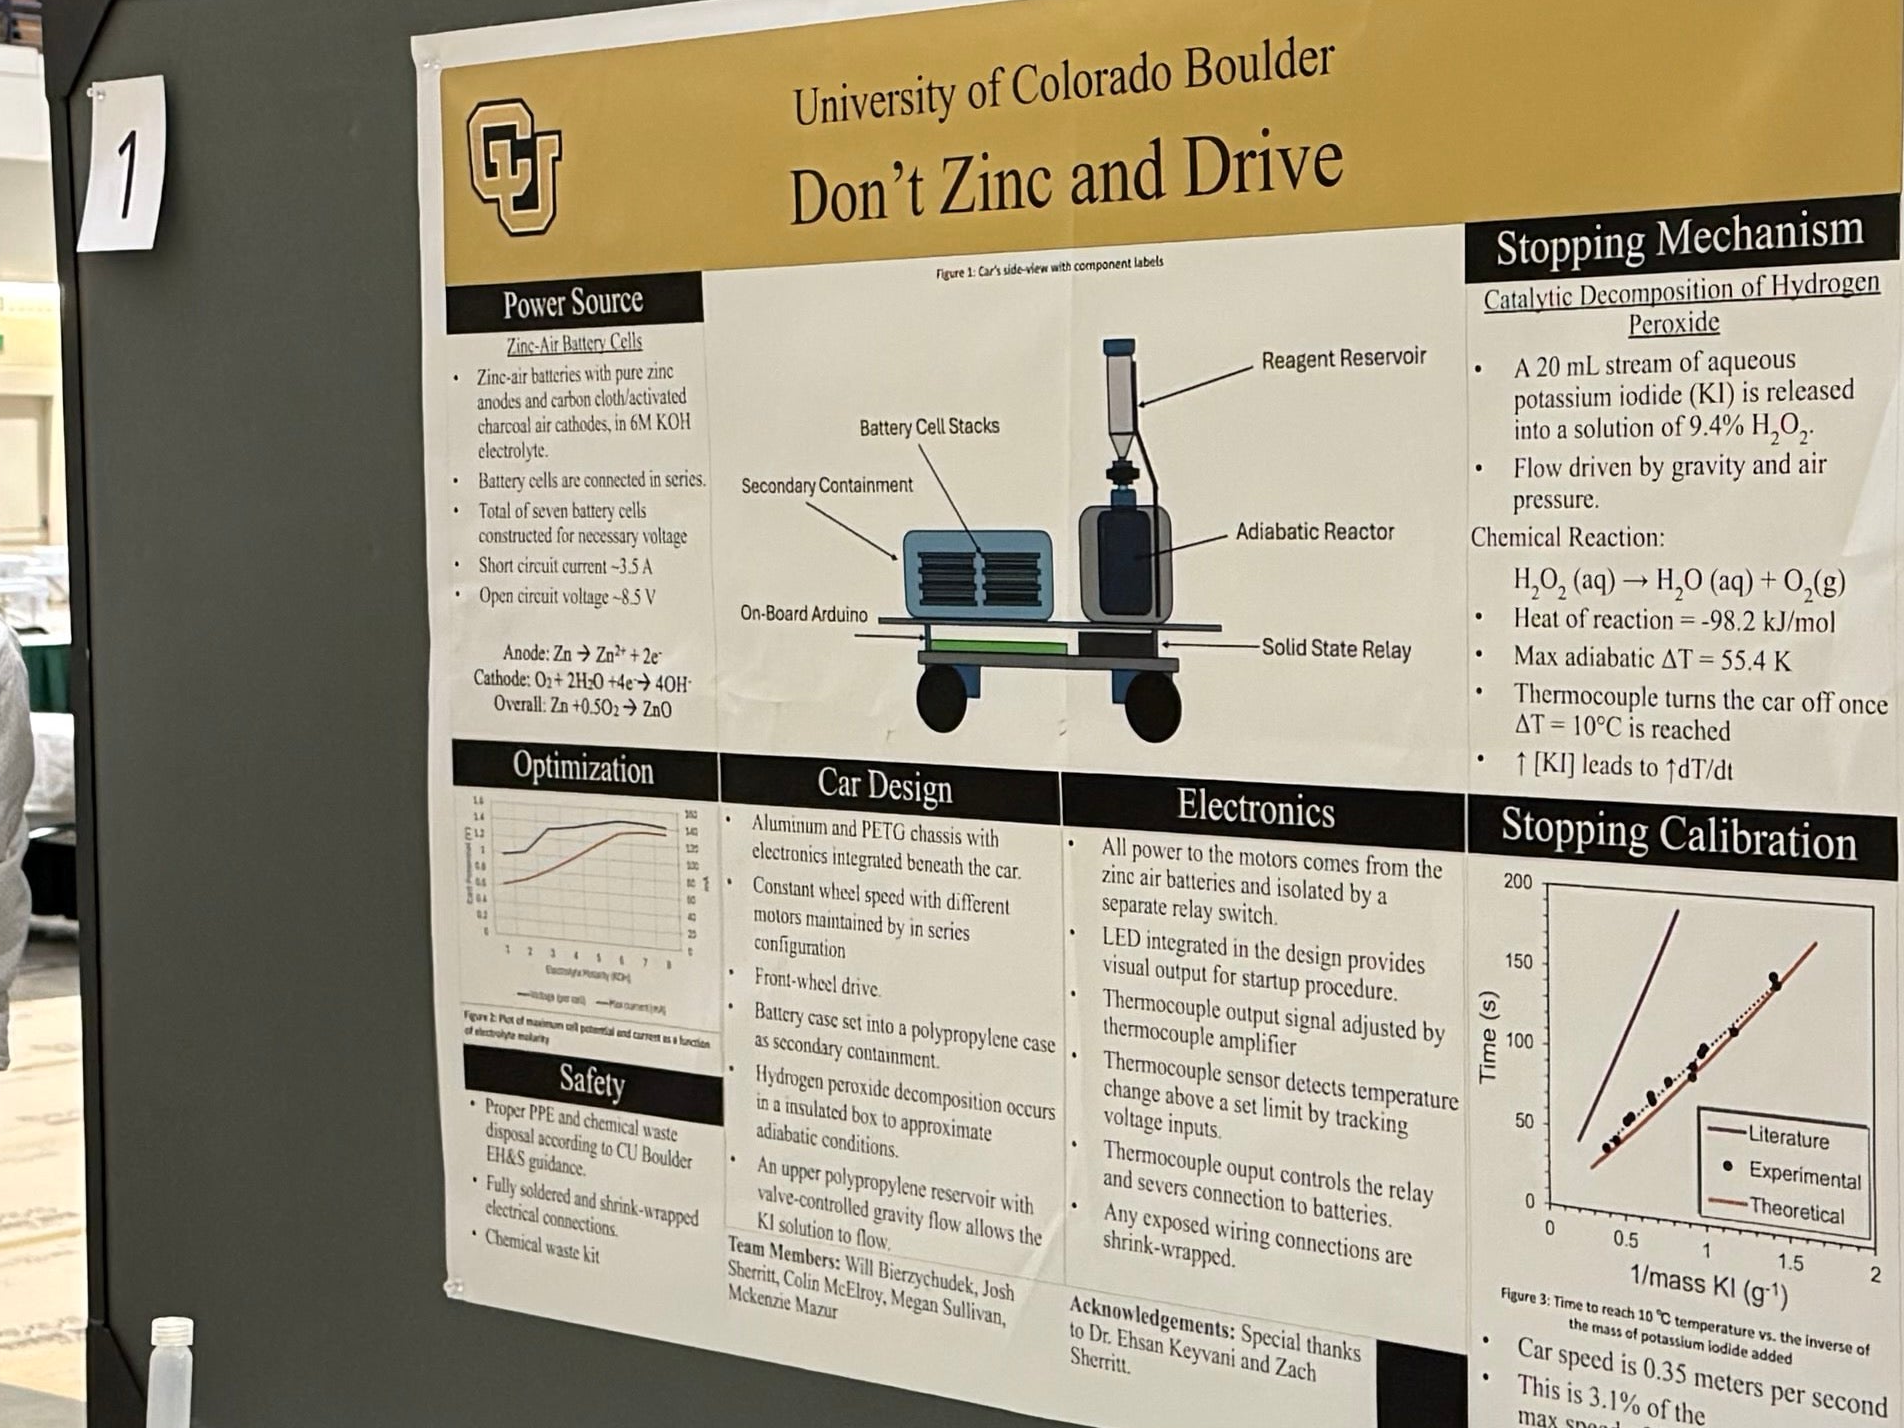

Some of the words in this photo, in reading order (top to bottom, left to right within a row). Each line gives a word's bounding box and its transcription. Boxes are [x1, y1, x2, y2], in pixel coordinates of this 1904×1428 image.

[793, 74, 956, 126] University
[967, 65, 1005, 109] of
[1011, 50, 1172, 105] Colorado
[1184, 34, 1336, 88] Boulder
[118, 129, 137, 220] 1
[466, 98, 562, 237] CU
[939, 150, 1052, 214] Zinc
[1070, 136, 1166, 205] and
[1182, 126, 1343, 197] Drive
[1496, 223, 1645, 271] Stopping
[1655, 209, 1864, 256] Mechanism
[503, 290, 566, 319] Power
[570, 286, 643, 315] Source
[1482, 283, 1574, 316] Catalytic
[1578, 275, 1734, 312] Decomposition
[1739, 273, 1765, 305] of
[1769, 267, 1882, 303] Hydrogen
[1628, 309, 1720, 337] Peroxide
[505, 334, 560, 359] Zinc-Air
[562, 332, 607, 357] Battery
[610, 330, 643, 355] Cells
[1261, 349, 1336, 373] Reagent
[1339, 344, 1427, 367] Reservoir
[859, 418, 912, 439] Battery
[915, 416, 946, 435] Cell
[948, 415, 1000, 435] Stacks
[1514, 456, 1562, 478] Flow
[1568, 455, 1631, 477] driven
[1638, 454, 1664, 482] by
[1671, 453, 1746, 482] gravity
[1752, 451, 1790, 475] and
[1797, 450, 1828, 474] air
[741, 475, 816, 497] Secondary
[818, 475, 913, 494] Containment
[1512, 492, 1599, 516] pressure.
[1235, 520, 1319, 540] Adiabatic
[1323, 521, 1395, 541] Reactor
[1470, 525, 1560, 547] Chemical
[1568, 525, 1664, 547] Reaction:
[740, 603, 808, 621] On-Board
[810, 604, 868, 623] Arduino
[1261, 636, 1307, 656] Solid
[1311, 638, 1357, 658] State
[1362, 638, 1412, 664] Relay
[512, 748, 654, 784] Optimization
[817, 765, 862, 797] Car
[867, 768, 953, 809] Design
[1176, 786, 1335, 828] Electronics
[1502, 805, 1649, 855] Stopping
[1659, 814, 1857, 861] Calibration
[1503, 872, 1532, 890] 200
[1505, 952, 1533, 970] 150
[754, 965, 837, 993] Front-wheel
[840, 975, 881, 998] drive.
[1478, 990, 1501, 1020] (s)
[1478, 1028, 1497, 1085] Time
[1506, 1031, 1533, 1049] 100
[559, 1062, 625, 1104] Safety
[1515, 1111, 1534, 1129] 50
[1748, 1123, 1830, 1150] Literature
[1749, 1159, 1861, 1190] Experimental
[1749, 1195, 1844, 1225] Theoretical
[484, 1227, 542, 1253] Chemical
[545, 1242, 580, 1260] waste
[582, 1244, 600, 1264] kit
[727, 1234, 765, 1257] Team
[769, 1241, 840, 1270] Members:
[844, 1254, 873, 1276] Will
[878, 1260, 978, 1297] Bierzychudek,
[981, 1278, 1014, 1302] Josh
[727, 1258, 780, 1287] Sherritt,
[782, 1268, 819, 1292] Colin
[823, 1275, 887, 1308] McElroy,
[890, 1287, 938, 1315] Megan
[942, 1297, 1006, 1328] Sullivan,
[728, 1282, 791, 1311] Mckenzie
[795, 1295, 838, 1320] Mazur
[1069, 1294, 1235, 1340] Acknowledgements:
[1241, 1322, 1300, 1352] Special
[1306, 1334, 1361, 1362] thanks
[1069, 1321, 1084, 1339] to
[1088, 1322, 1111, 1345] Dr.
[1116, 1327, 1163, 1354] Ehsan
[1168, 1336, 1235, 1368] Keyvani
[1240, 1353, 1270, 1374] and
[1274, 1356, 1316, 1382] Zach
[1069, 1346, 1131, 1375] Sherritt.
[1517, 1335, 1553, 1361] Car
[1558, 1348, 1613, 1372] speed
[1620, 1352, 1637, 1376] is
[1643, 1356, 1686, 1384] 0.35
[1694, 1371, 1763, 1397] meters
[1770, 1384, 1806, 1406] per
[1811, 1391, 1888, 1418] second
